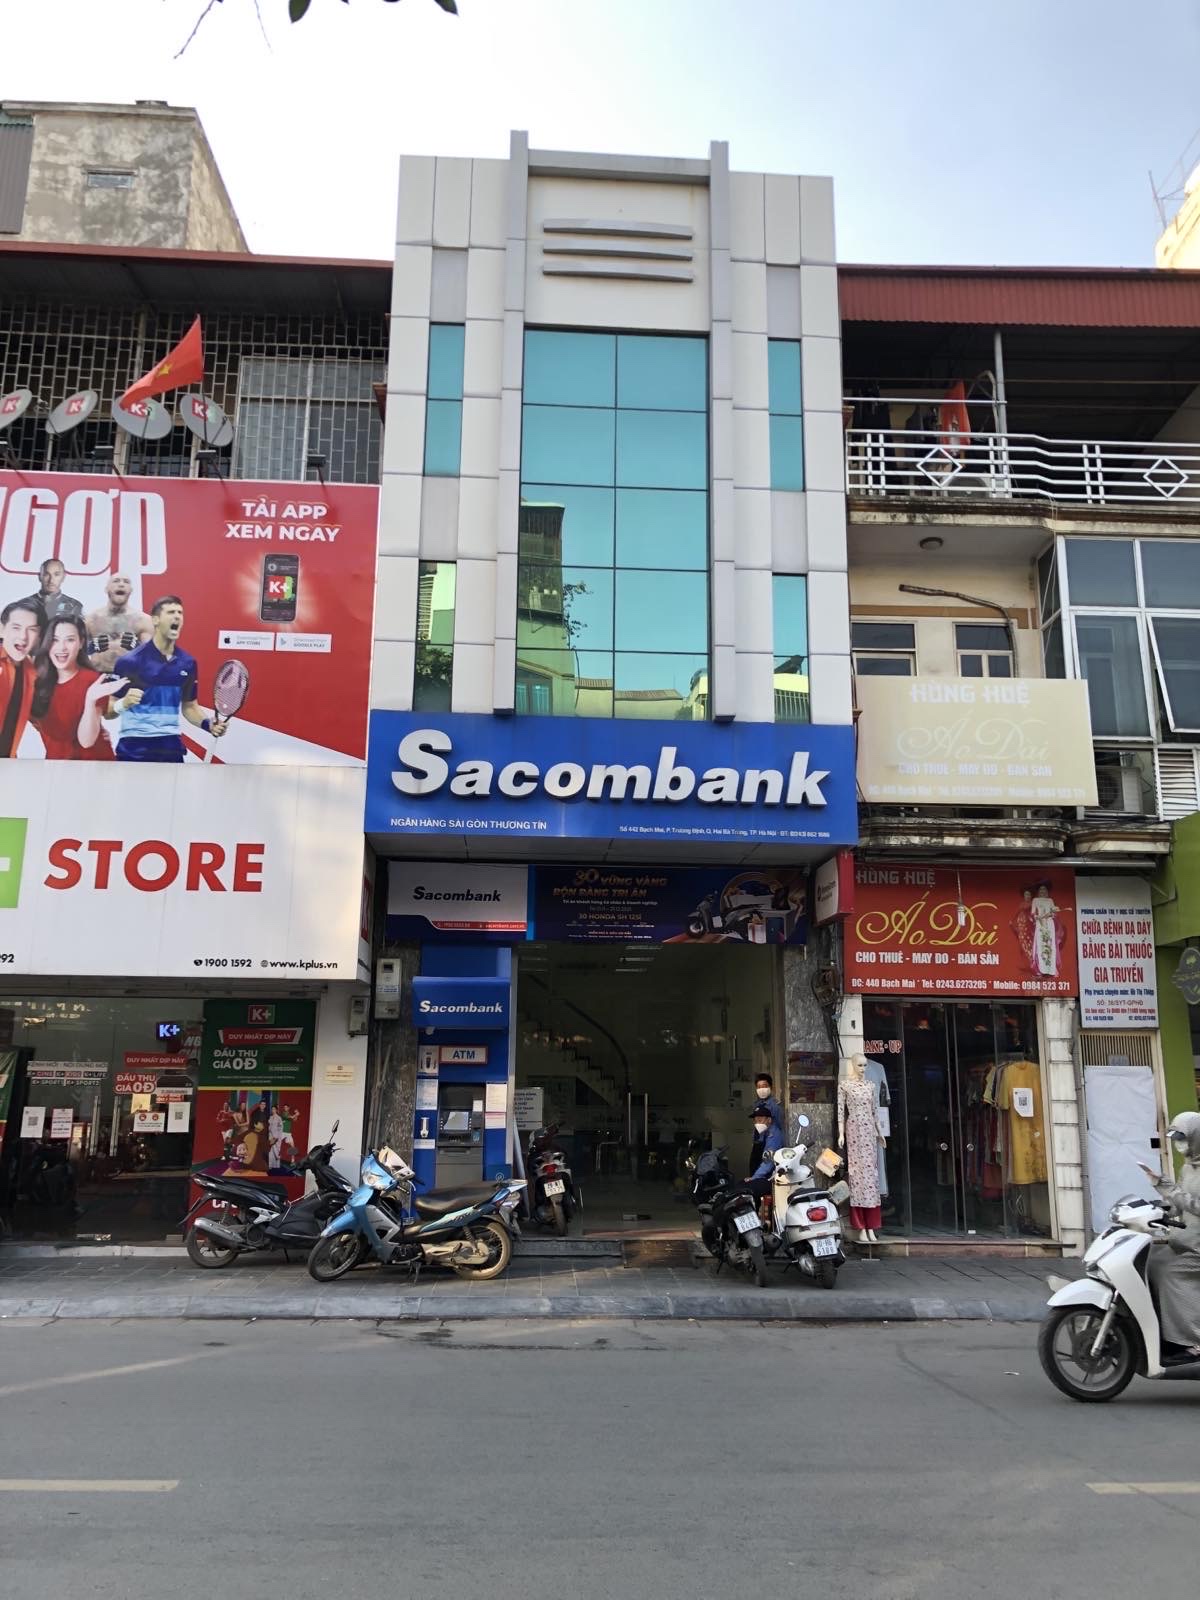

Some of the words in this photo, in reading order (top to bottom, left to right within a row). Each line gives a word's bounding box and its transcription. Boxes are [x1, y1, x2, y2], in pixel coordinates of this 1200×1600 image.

[241, 498, 276, 517] TẢI
[281, 504, 327, 520] APP
[225, 523, 273, 540] XEM
[279, 526, 340, 542] NGAY
[976, 718, 1050, 761] Dài
[391, 729, 831, 807] Sacombank
[391, 817, 418, 827] NGÂN
[419, 818, 446, 828] HÀNG
[448, 818, 464, 828] SÀI
[466, 819, 488, 829] GÒN
[490, 820, 530, 830] THƯƠNG
[532, 820, 547, 830] TÍN
[44, 838, 265, 893] STORE
[413, 886, 501, 902] Sacombank
[589, 913, 615, 921] HONDA
[855, 890, 928, 945] Áo
[929, 901, 999, 946] Dài
[1081, 918, 1101, 935] CHỮA
[1103, 918, 1123, 938] BỆNH
[1125, 921, 1136, 938] DẠ
[1137, 918, 1151, 935] DÀY
[1082, 937, 1105, 959] BẰNG
[1108, 940, 1123, 959] BÀI
[1125, 938, 1152, 959] THUỐC
[0, 953, 14, 964] 92
[204, 958, 229, 968] 1900
[231, 958, 252, 968] 1592
[269, 959, 338, 971] www.kplus.vn
[855, 951, 876, 963] CHO
[878, 950, 904, 963] THUÊ
[912, 952, 932, 964] MAY
[935, 952, 949, 964] ĐO
[958, 952, 977, 965] BÁN
[1094, 967, 1109, 983] GIA
[866, 978, 880, 987] 440
[881, 978, 899, 990] Bạch
[901, 979, 916, 988] Mai
[922, 979, 934, 988] Tel:
[993, 980, 1020, 990] Mobile:
[1042, 981, 1056, 991] 523
[1058, 982, 1070, 991] 371
[419, 1000, 503, 1013] Sacombank
[252, 1008, 271, 1021] K+
[160, 1024, 180, 1038] K+
[238, 1049, 258, 1058] THU
[452, 1050, 475, 1060] ATM
[137, 1074, 155, 1082] THU
[115, 1083, 131, 1092] GIÁ
